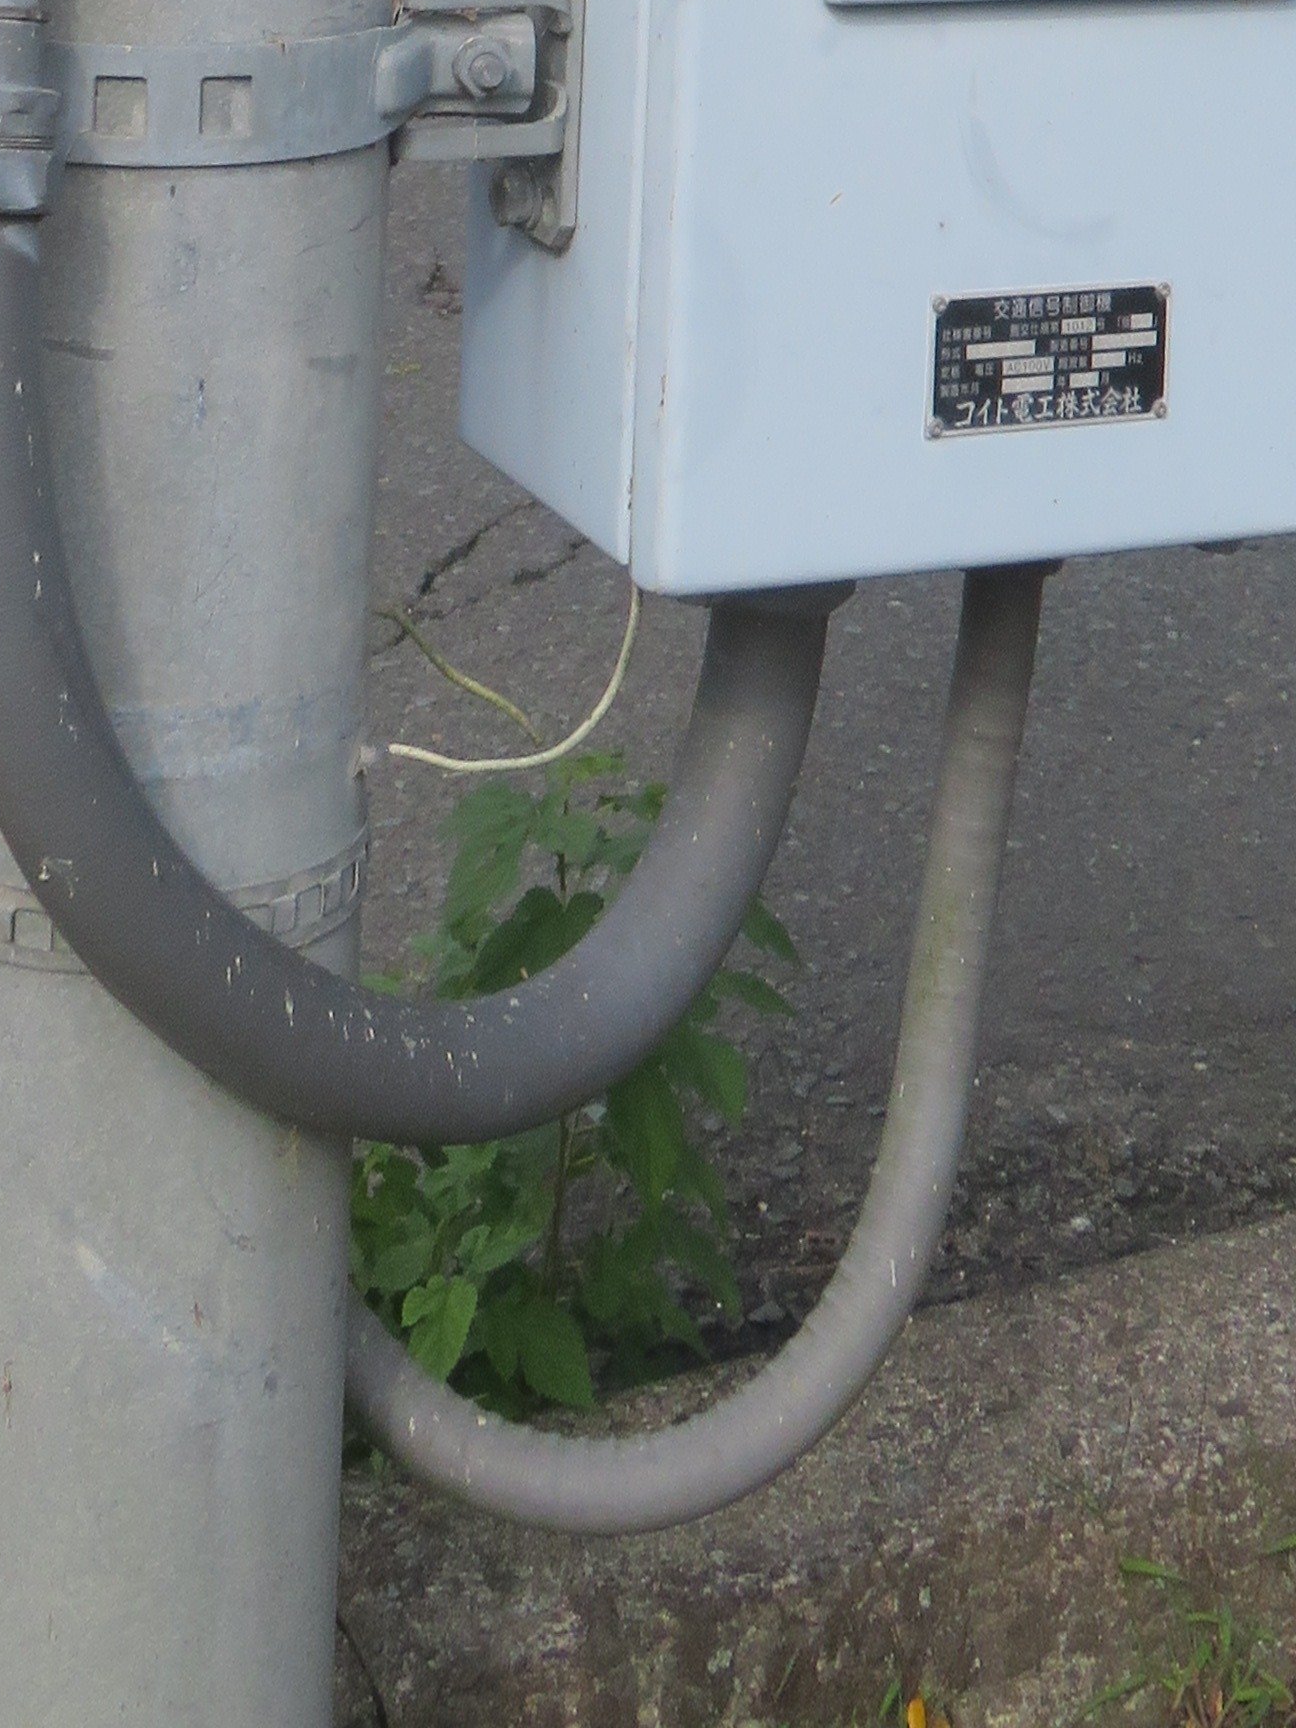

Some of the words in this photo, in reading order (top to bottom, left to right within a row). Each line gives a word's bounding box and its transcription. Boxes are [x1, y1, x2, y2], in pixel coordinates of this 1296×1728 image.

[993, 293, 1112, 320] 交通信号制御機
[954, 386, 1142, 427] コイト電工株式会社
